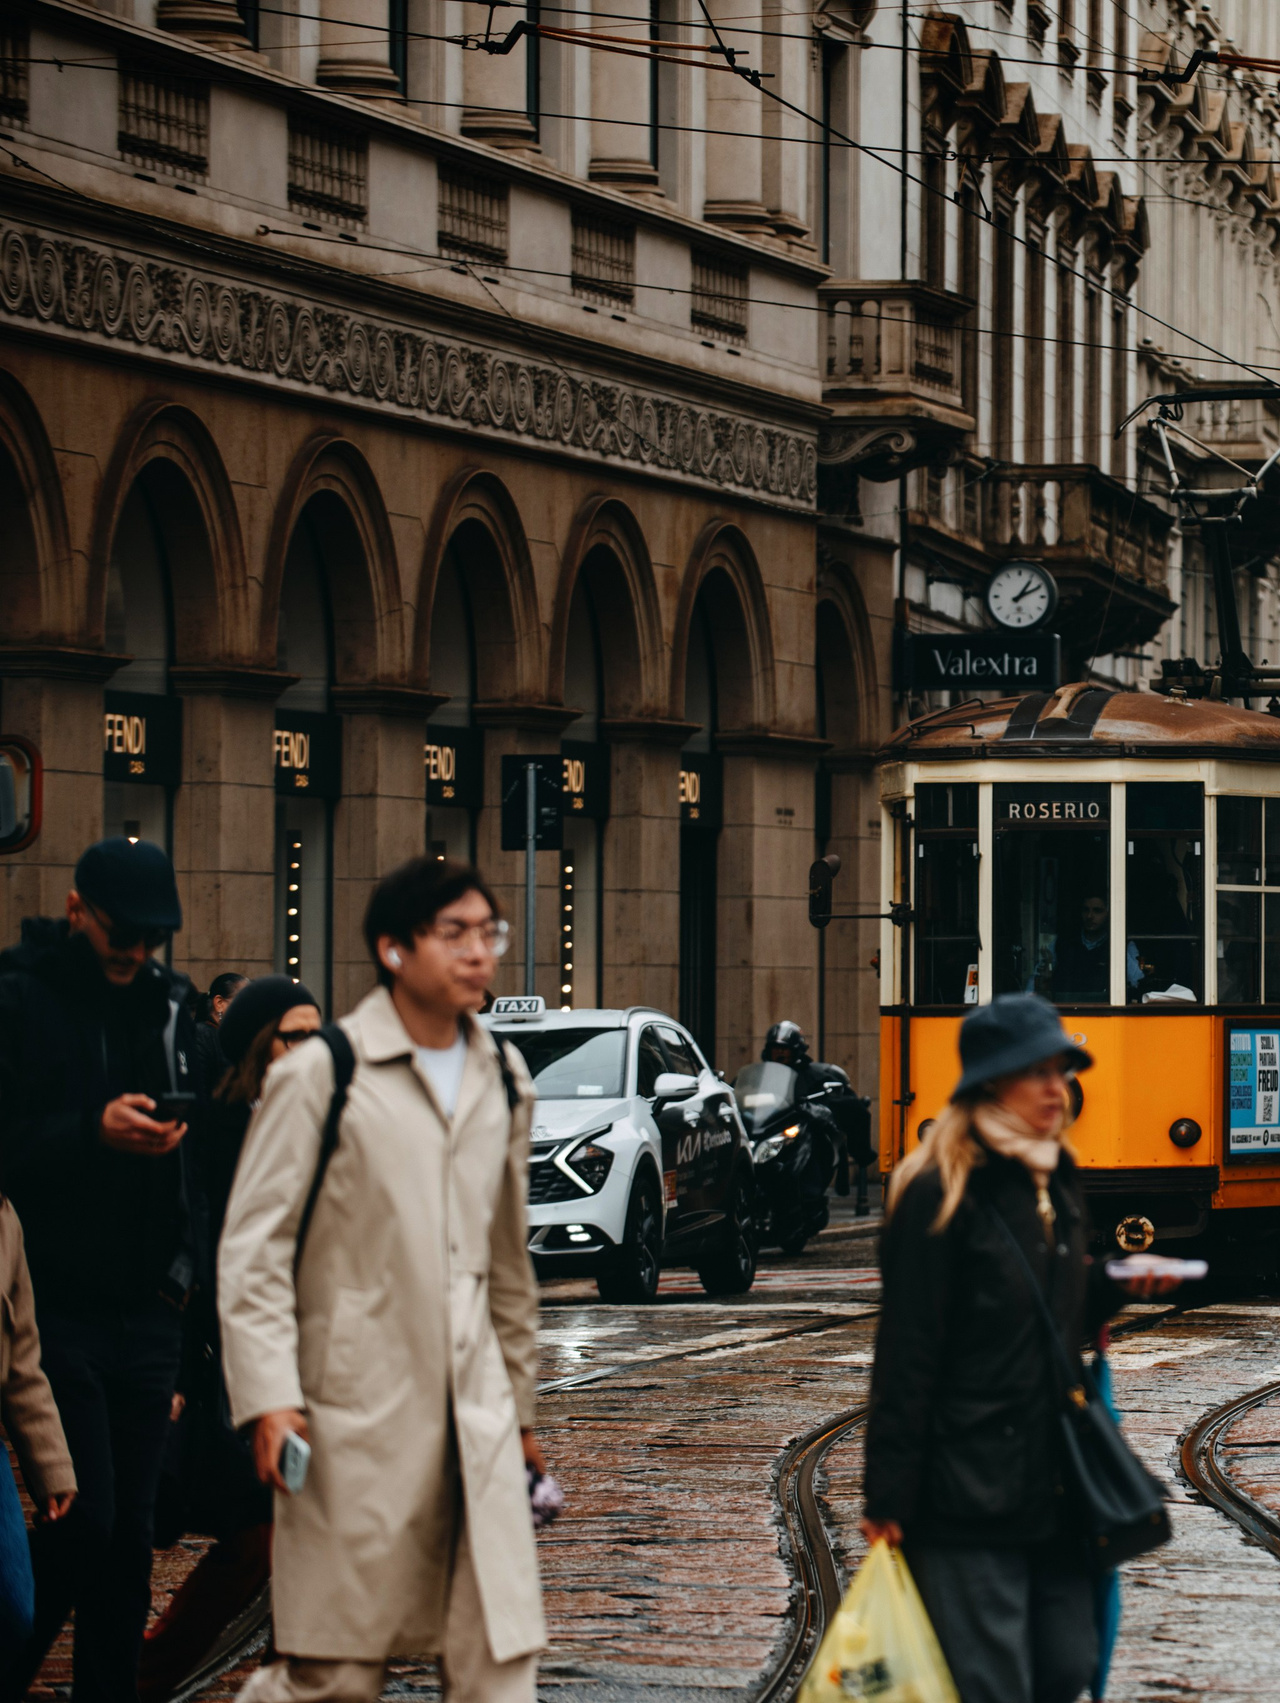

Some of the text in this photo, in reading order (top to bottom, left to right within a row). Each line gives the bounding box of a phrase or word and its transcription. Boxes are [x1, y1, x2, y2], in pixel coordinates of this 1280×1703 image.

[933, 649, 1038, 675] Valextra
[105, 713, 146, 754] FENDI
[273, 730, 310, 769] FENDI
[1009, 802, 1100, 819] ROSERIO
[497, 1001, 537, 1012] TAXI
[1257, 1069, 1279, 1092] FREUD
